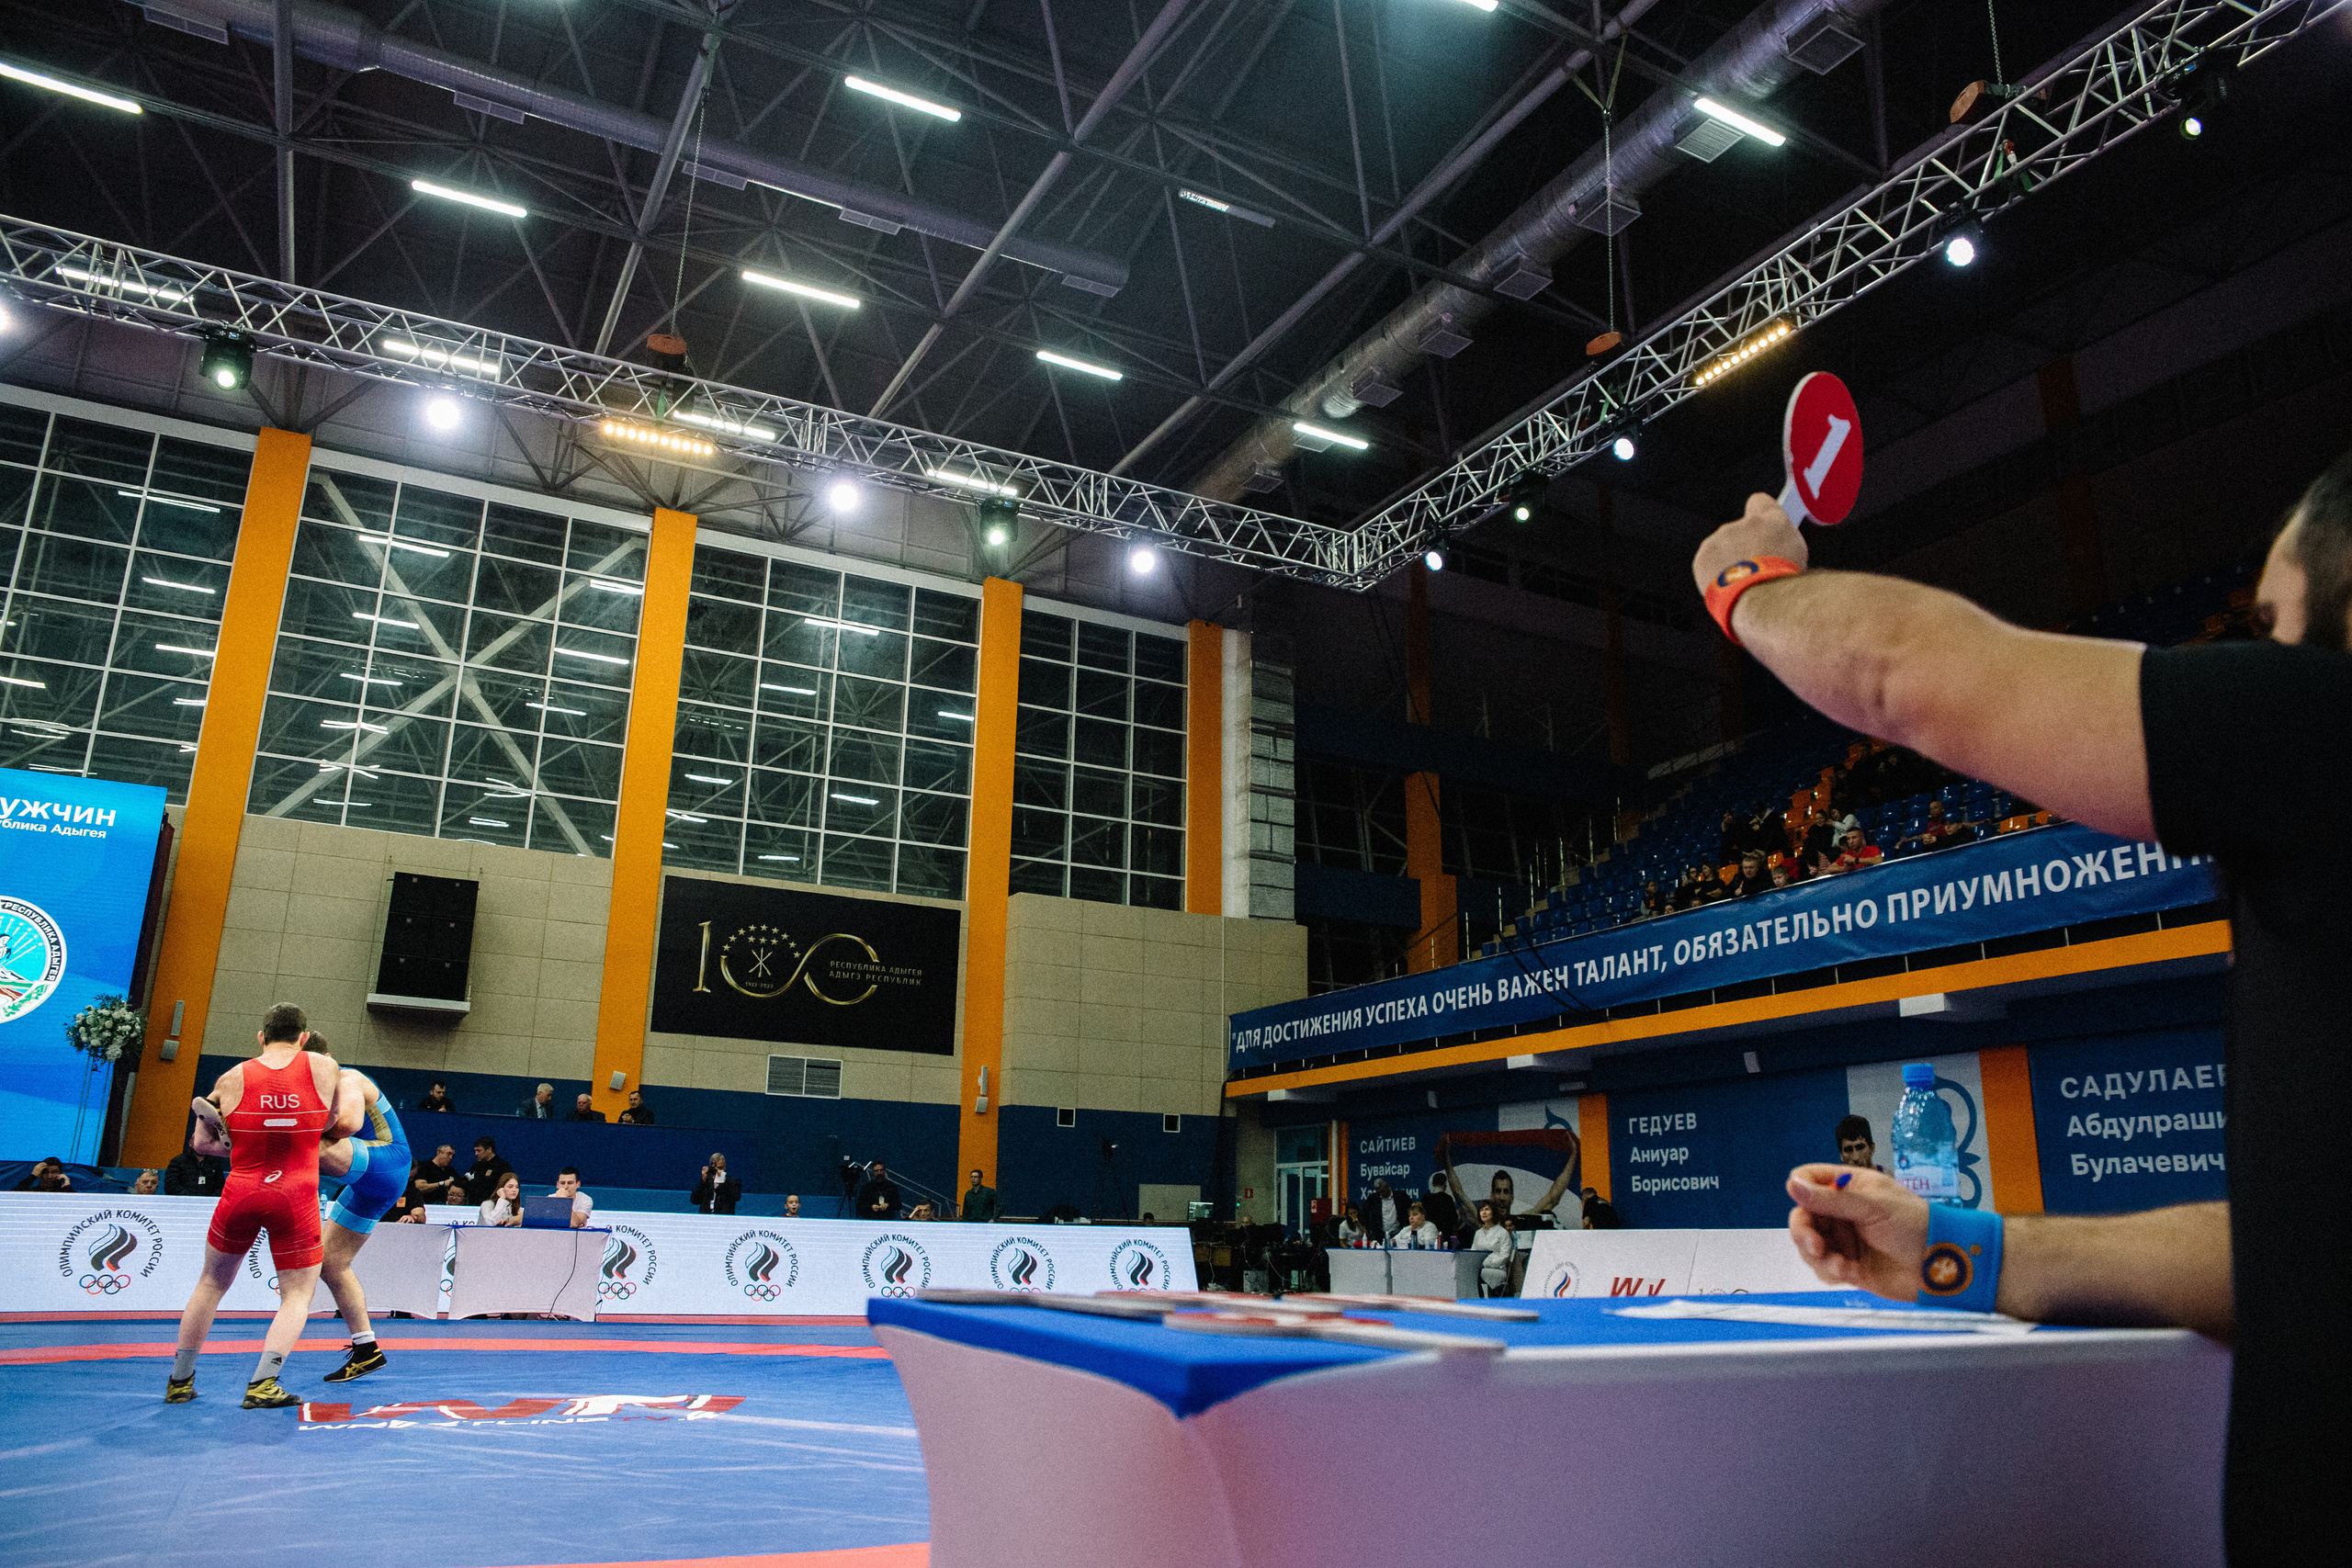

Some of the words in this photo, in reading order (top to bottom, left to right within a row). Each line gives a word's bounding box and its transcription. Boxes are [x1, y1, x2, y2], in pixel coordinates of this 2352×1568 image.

[1804, 414, 1851, 500] 1
[0, 796, 117, 827] УЖЧИН
[51, 824, 107, 839] Адыгея
[5, 902, 58, 943] РЕСПУБЛИКА
[47, 945, 62, 981] АДЫГЕЯ
[1262, 1008, 1362, 1049] ДОСТИЖЕНИЯ
[1365, 995, 1428, 1027] УСПЕХА
[1432, 983, 1493, 1014] ОЧЕНЬ
[1498, 965, 1568, 1002] ВАЖЕН
[1574, 944, 1668, 987] ТАЛАНТ,
[1674, 899, 1878, 965] ОБЯЗАТЕЛЬНО
[1887, 841, 2214, 924] ПРИУМНОЖЕН
[829, 970, 861, 980] АДЫГЭ
[865, 974, 922, 986] РЕСПУБЛИК
[830, 960, 887, 973] РЕСПУБЛИКА
[888, 966, 922, 976] АДЫГЕЯ
[260, 1094, 300, 1110] RUS
[1629, 1112, 1697, 1136] ГЕДУЕВ
[2067, 1111, 2227, 1142] Абдулраши
[1360, 1135, 1416, 1154] САЙТИЕВ
[1630, 1146, 1689, 1168] Аниуар
[1360, 1161, 1410, 1181] Бувайсар
[2071, 1153, 2226, 1182] Булачевич
[1632, 1175, 1719, 1196] Борисович
[59, 1209, 112, 1277] ОЛИМПИЙСКИЙ
[116, 1210, 161, 1235] КОМИТЕТ
[140, 1237, 164, 1278] РОССИИ
[616, 1224, 652, 1248] КОМИТЕТ
[643, 1249, 657, 1285] РОССИИ
[725, 1229, 756, 1286] ОЛИМПИЙСКИЙ
[758, 1230, 794, 1252] КОМИТЕТ
[786, 1253, 799, 1288] РОССИИ
[862, 1234, 890, 1289] ОЛИМПИЙСКИЙ
[891, 1234, 926, 1256] КОМИТЕТ
[920, 1256, 932, 1289] РОССИИ
[989, 1236, 1016, 1290] ОЛИМПИЙСКИЙ
[1016, 1236, 1049, 1258] КОМИТЕТ
[1045, 1258, 1056, 1290] РОССИИ
[1109, 1238, 1133, 1291] ОЛИМПИЙСКИЙ
[1133, 1239, 1165, 1259] КОМИТЕТ
[1160, 1259, 1171, 1291] РОССИИ
